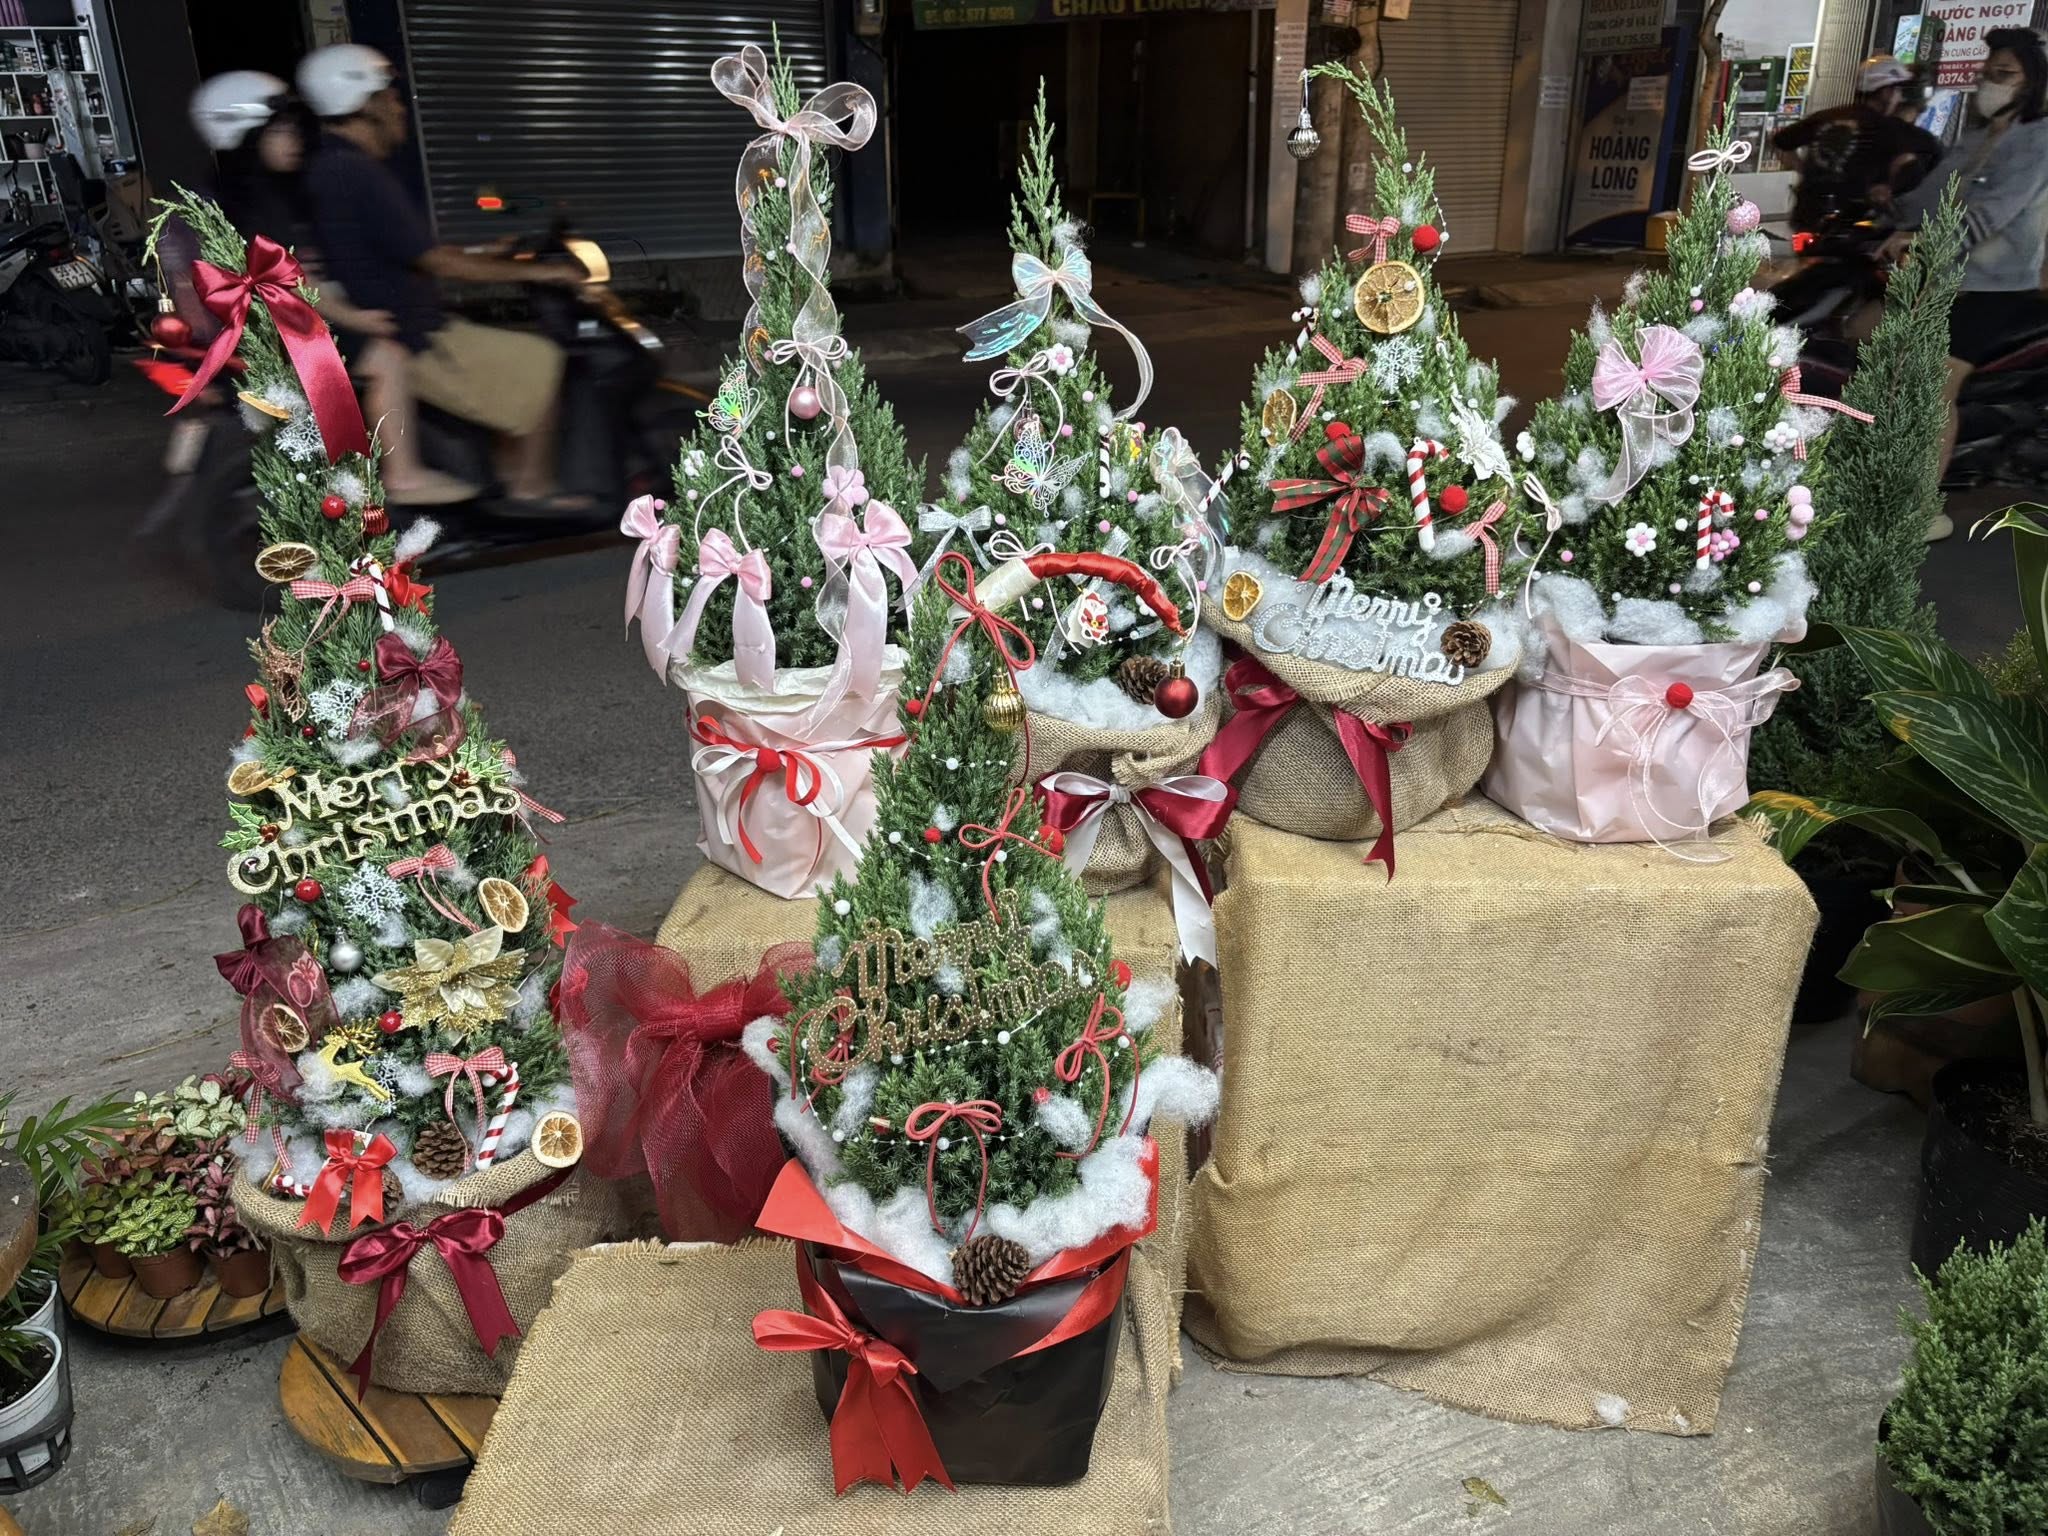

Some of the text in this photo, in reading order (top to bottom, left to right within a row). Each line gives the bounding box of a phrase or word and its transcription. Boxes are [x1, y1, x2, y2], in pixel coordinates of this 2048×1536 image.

[1979, 3, 2027, 19] NGỌT
[1589, 130, 1650, 160] HOÀNG
[1591, 166, 1638, 190] LONG
[1253, 602, 1465, 686] Christmas
[1296, 572, 1440, 646] Merry
[268, 754, 456, 832] Merry
[226, 778, 522, 895] Christmas
[831, 896, 1031, 992] Merry
[808, 949, 1100, 1073] Christmas
